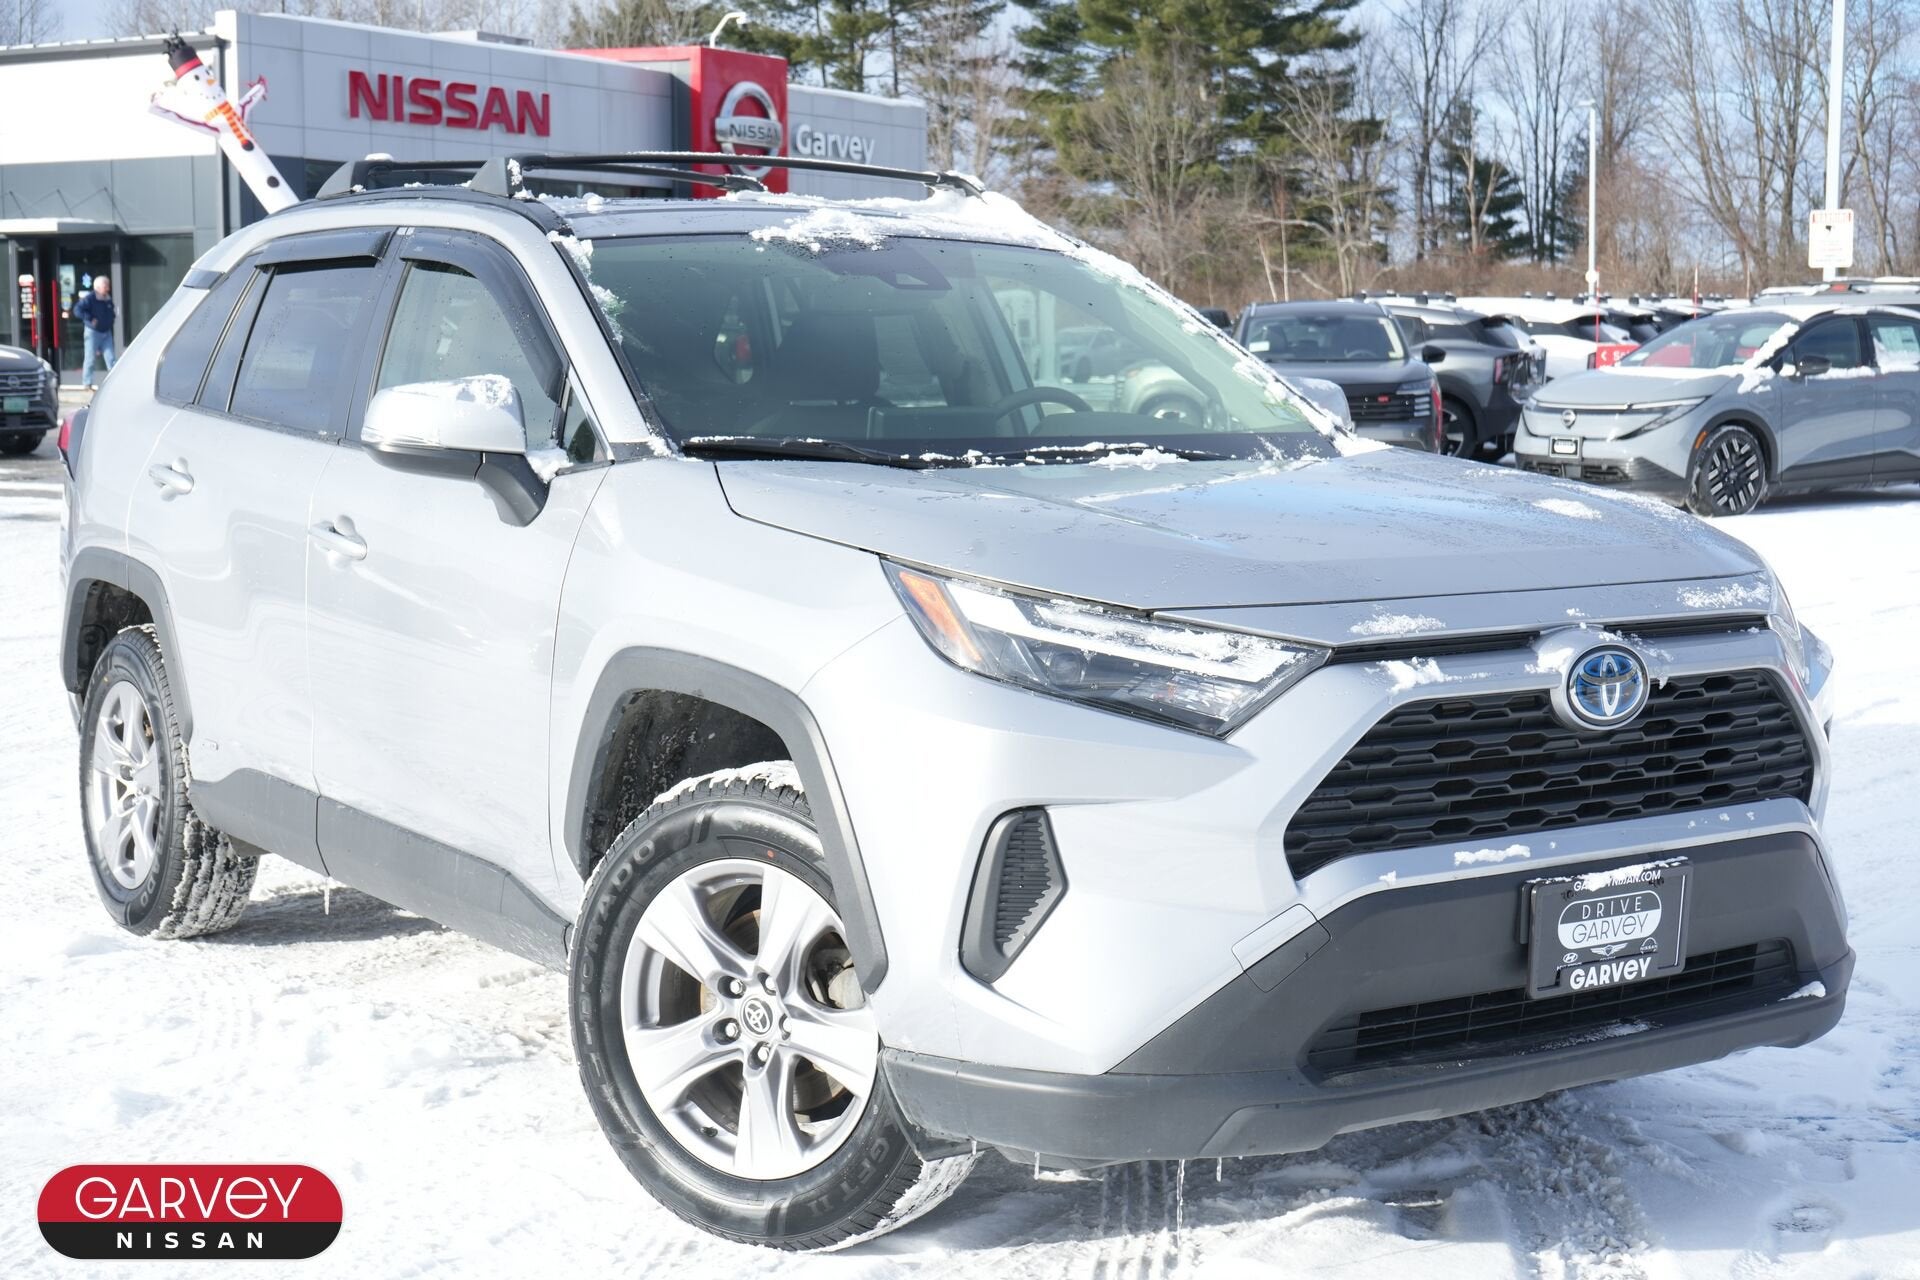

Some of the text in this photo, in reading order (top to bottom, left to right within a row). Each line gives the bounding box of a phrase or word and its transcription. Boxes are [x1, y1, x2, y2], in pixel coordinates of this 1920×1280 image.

[348, 70, 551, 137] NISSAN
[796, 124, 875, 164] Garvey
[1582, 896, 1642, 920] DRIVE
